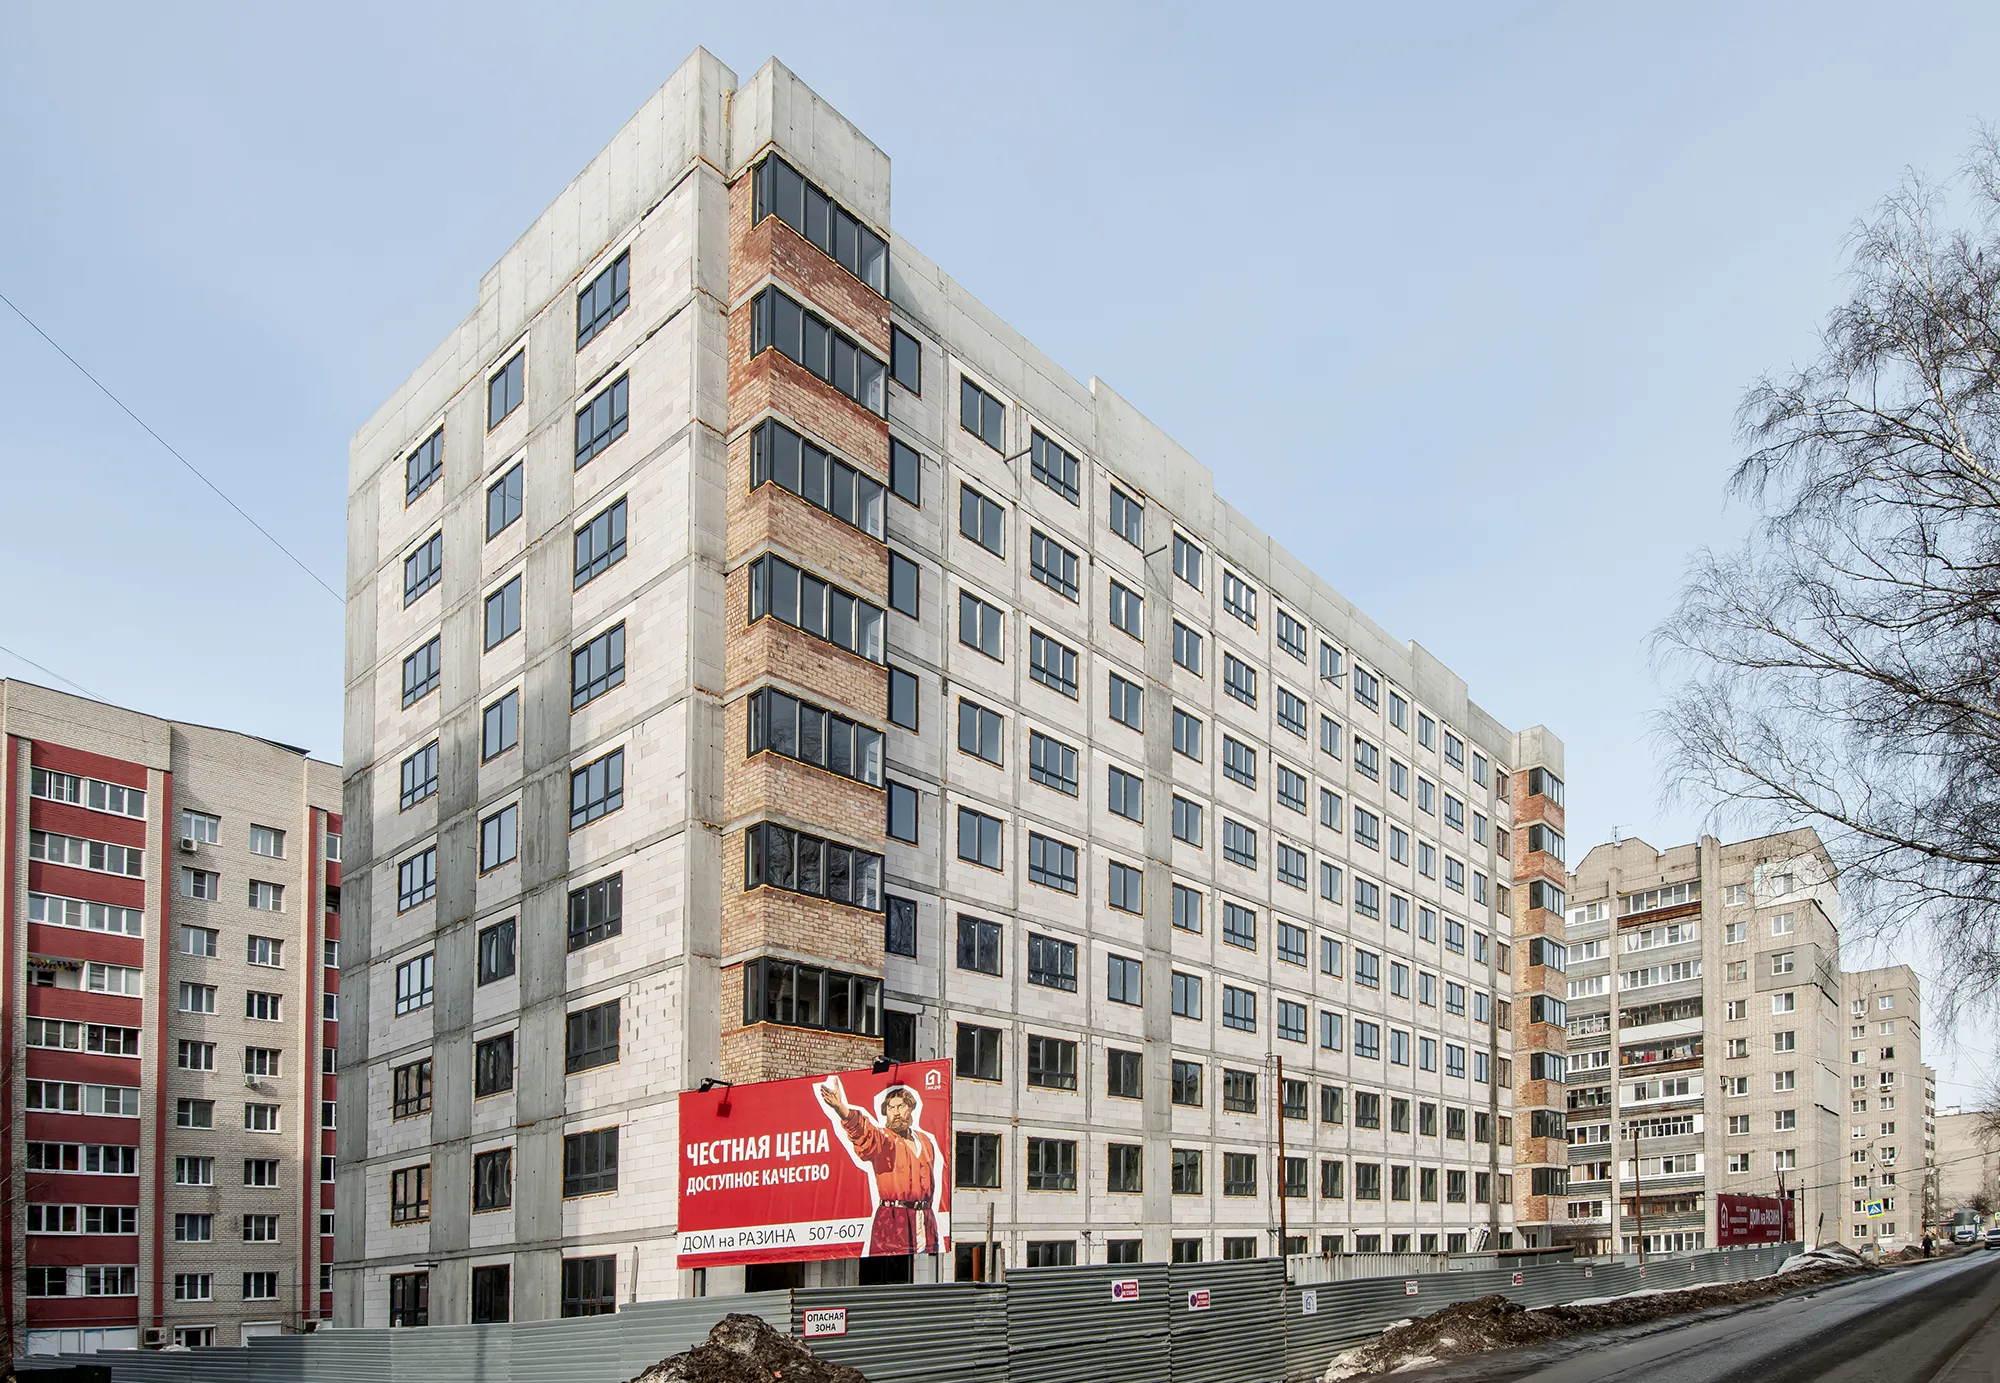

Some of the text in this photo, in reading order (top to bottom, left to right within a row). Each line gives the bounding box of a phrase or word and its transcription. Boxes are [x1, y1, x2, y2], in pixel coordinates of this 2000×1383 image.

[686, 1128, 830, 1167] ЧЕСТНАЯ ЦЕНА
[686, 1163, 830, 1196] ДОСТУПНОЕ КАЧЕСТВО
[682, 1223, 864, 1253] ДОМ на РАЗИНА 507-607
[807, 1312, 844, 1322] ОПАСНАЯ
[815, 1323, 836, 1332] ЗОНА
